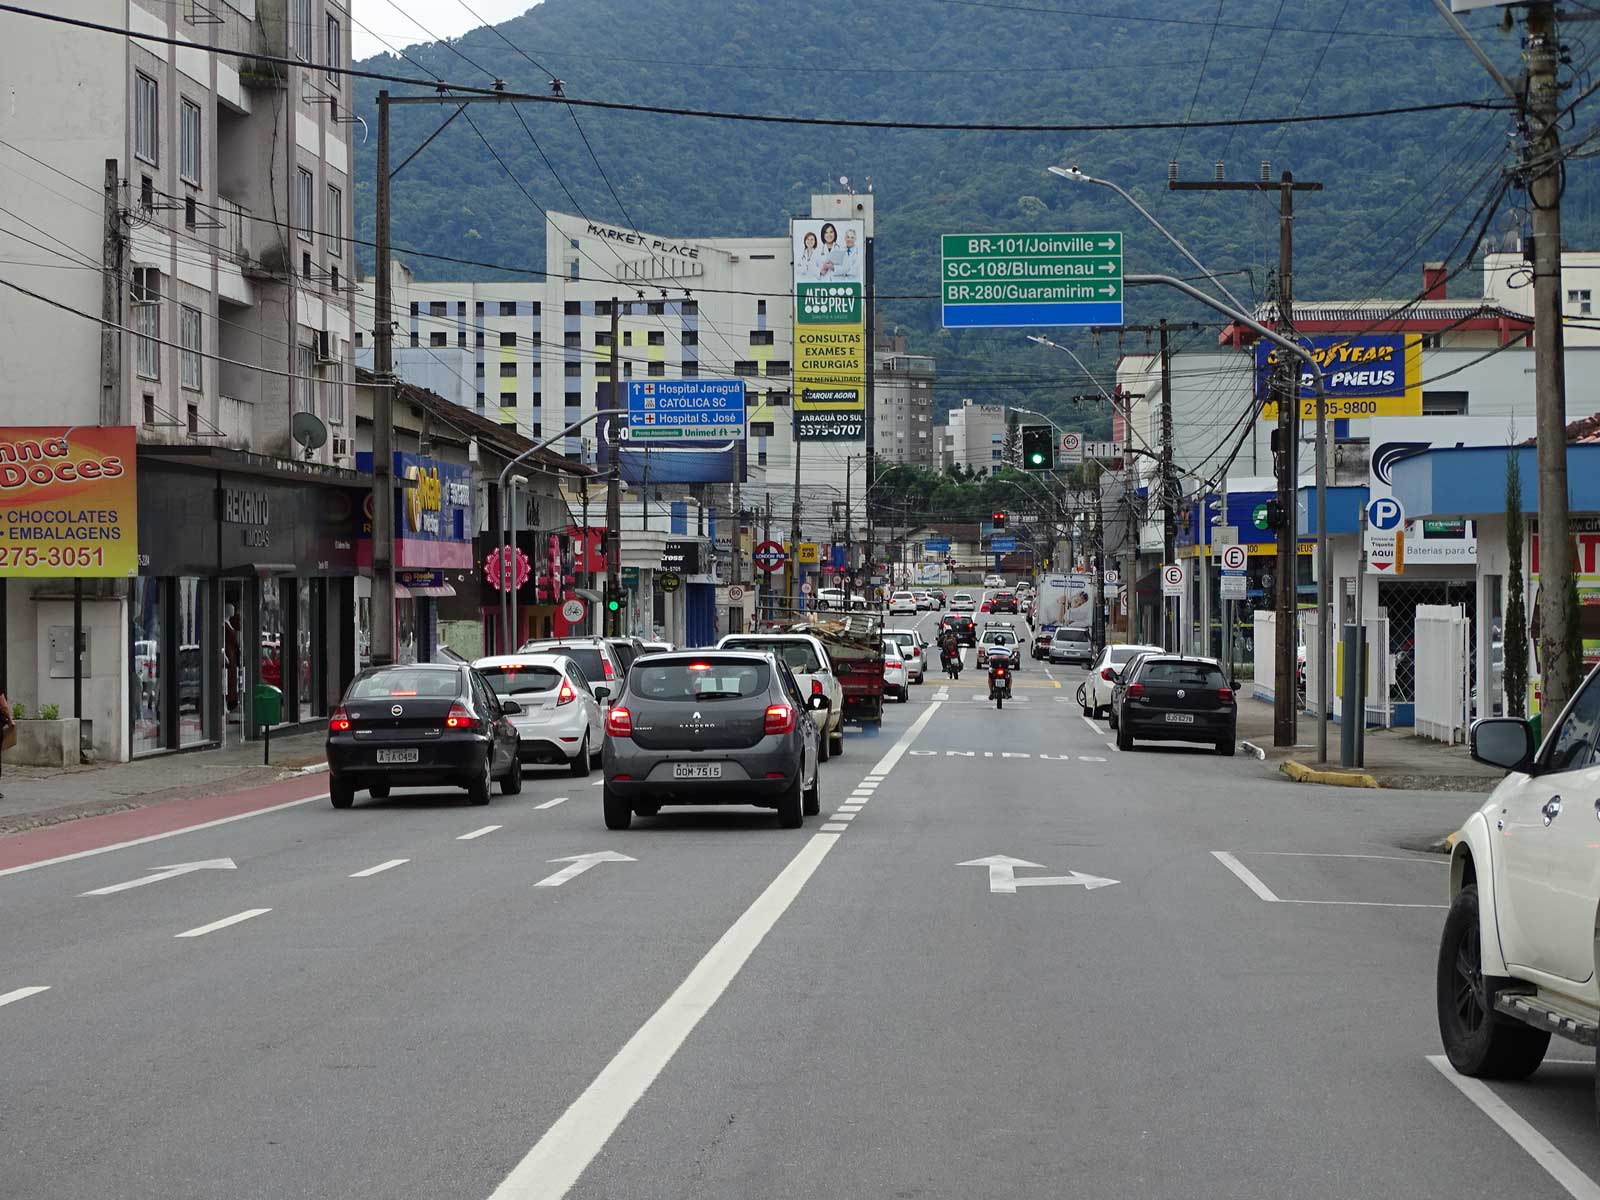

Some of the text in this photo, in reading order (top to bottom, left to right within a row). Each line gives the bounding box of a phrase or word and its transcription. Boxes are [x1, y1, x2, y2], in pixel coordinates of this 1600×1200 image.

[587, 224, 699, 259] MARKET PLACE
[968, 238, 1094, 254] BR-101/Joinville
[948, 261, 1094, 277] SC-108/Blumenau
[804, 287, 829, 305] MED
[948, 284, 1095, 300] BR-280/Guaramirim
[828, 297, 855, 313] PREV
[799, 334, 861, 344] CONSULTAS
[805, 347, 855, 356] EXAMES E
[801, 360, 859, 369] CIRURGIAS
[1331, 370, 1395, 387] PNEUS
[659, 383, 740, 395] Hospital Jaraguá
[659, 396, 727, 408] CATÓLICA SC
[659, 412, 736, 424] Hospital S. José
[800, 413, 835, 422] JARAGUÁ
[684, 429, 716, 437] Unimed
[1066, 437, 1076, 445] 60
[0, 457, 123, 487] Doces
[7, 510, 118, 523] CHOCOLATES
[1376, 501, 1397, 527] P
[9, 527, 121, 540] EMBALAGENS
[1407, 546, 1443, 555] Baterias
[1445, 547, 1465, 556] para
[1230, 551, 1239, 565] E
[1170, 570, 1178, 581] E
